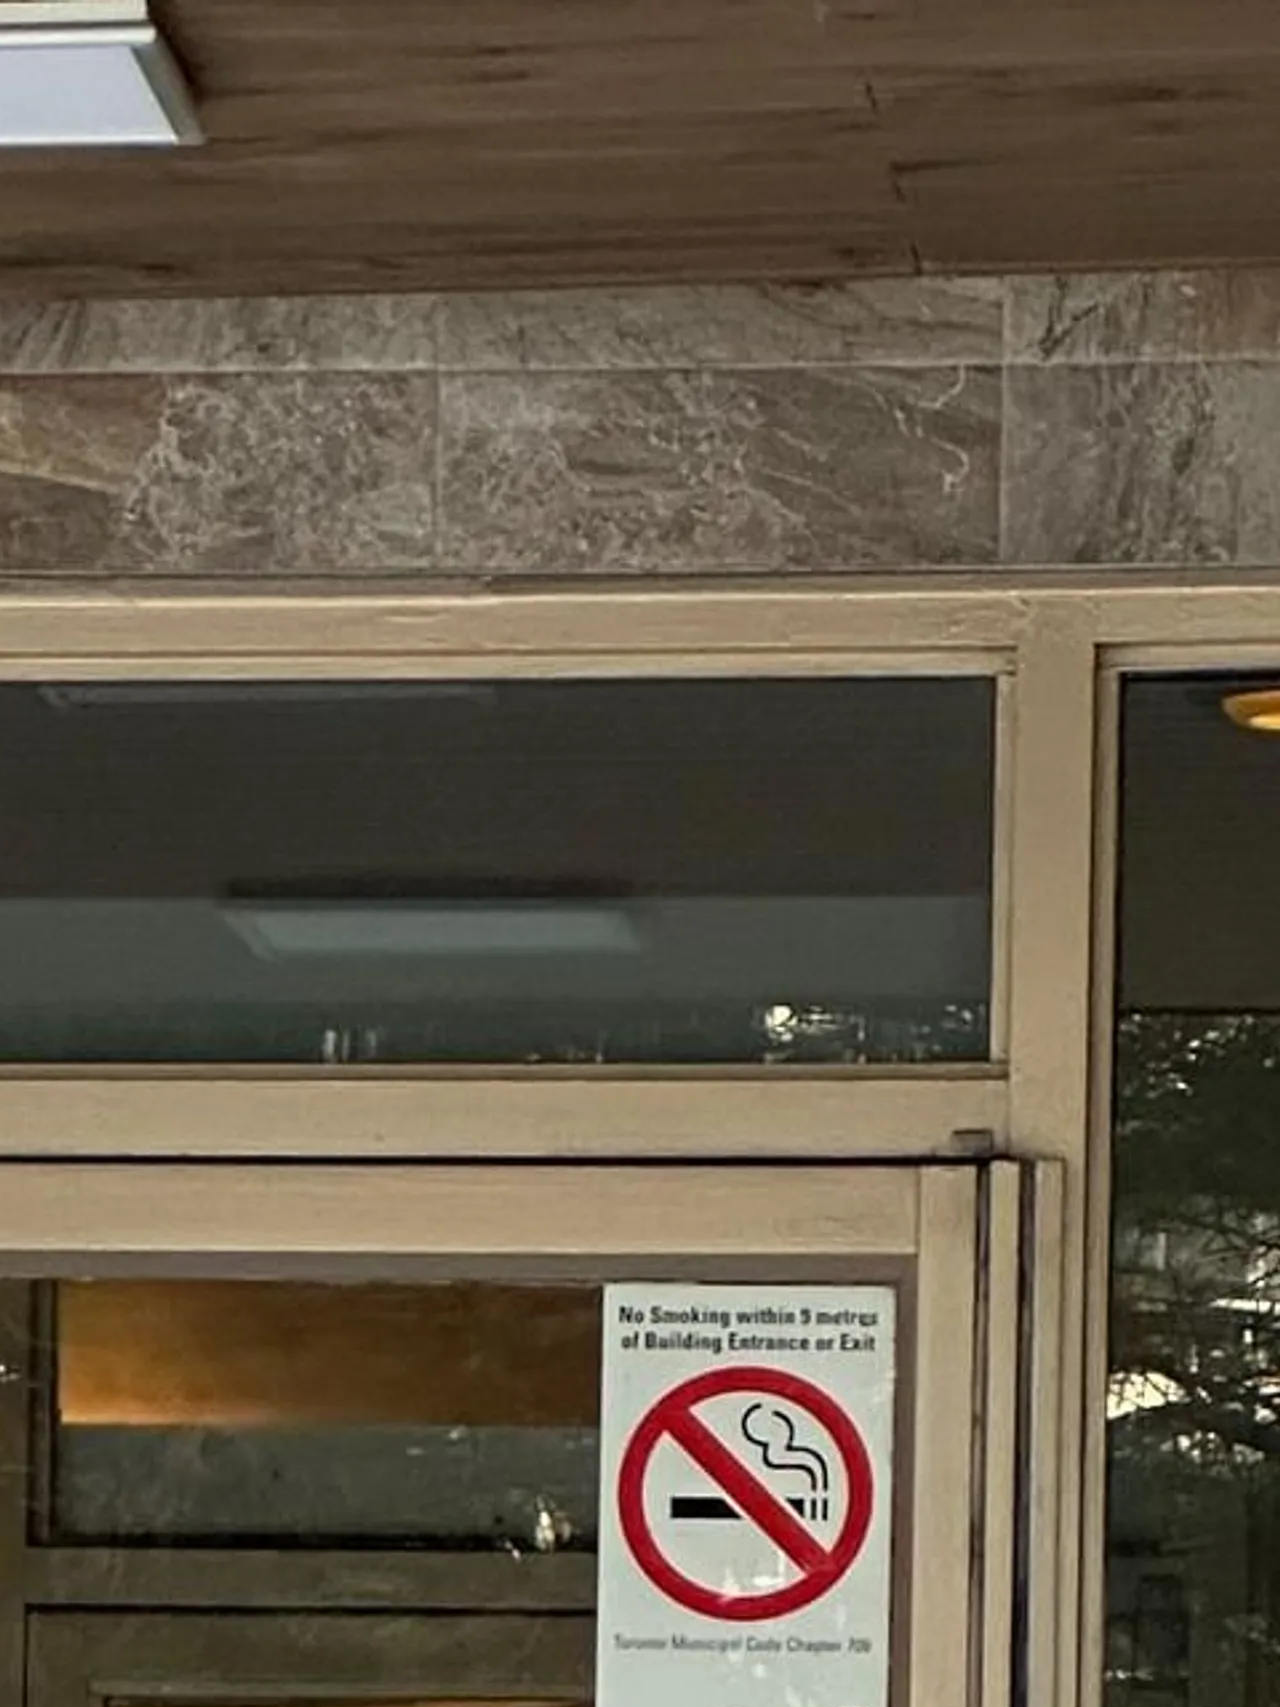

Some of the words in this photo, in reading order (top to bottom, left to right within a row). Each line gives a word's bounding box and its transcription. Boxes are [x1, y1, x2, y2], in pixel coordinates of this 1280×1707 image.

[619, 1306, 644, 1324] No
[649, 1306, 730, 1329] Smoking
[736, 1307, 795, 1324] within
[621, 1331, 639, 1350] of
[644, 1331, 722, 1355] Building
[727, 1332, 810, 1351] Entrance
[816, 1336, 835, 1350] or
[840, 1333, 876, 1351] Exit
